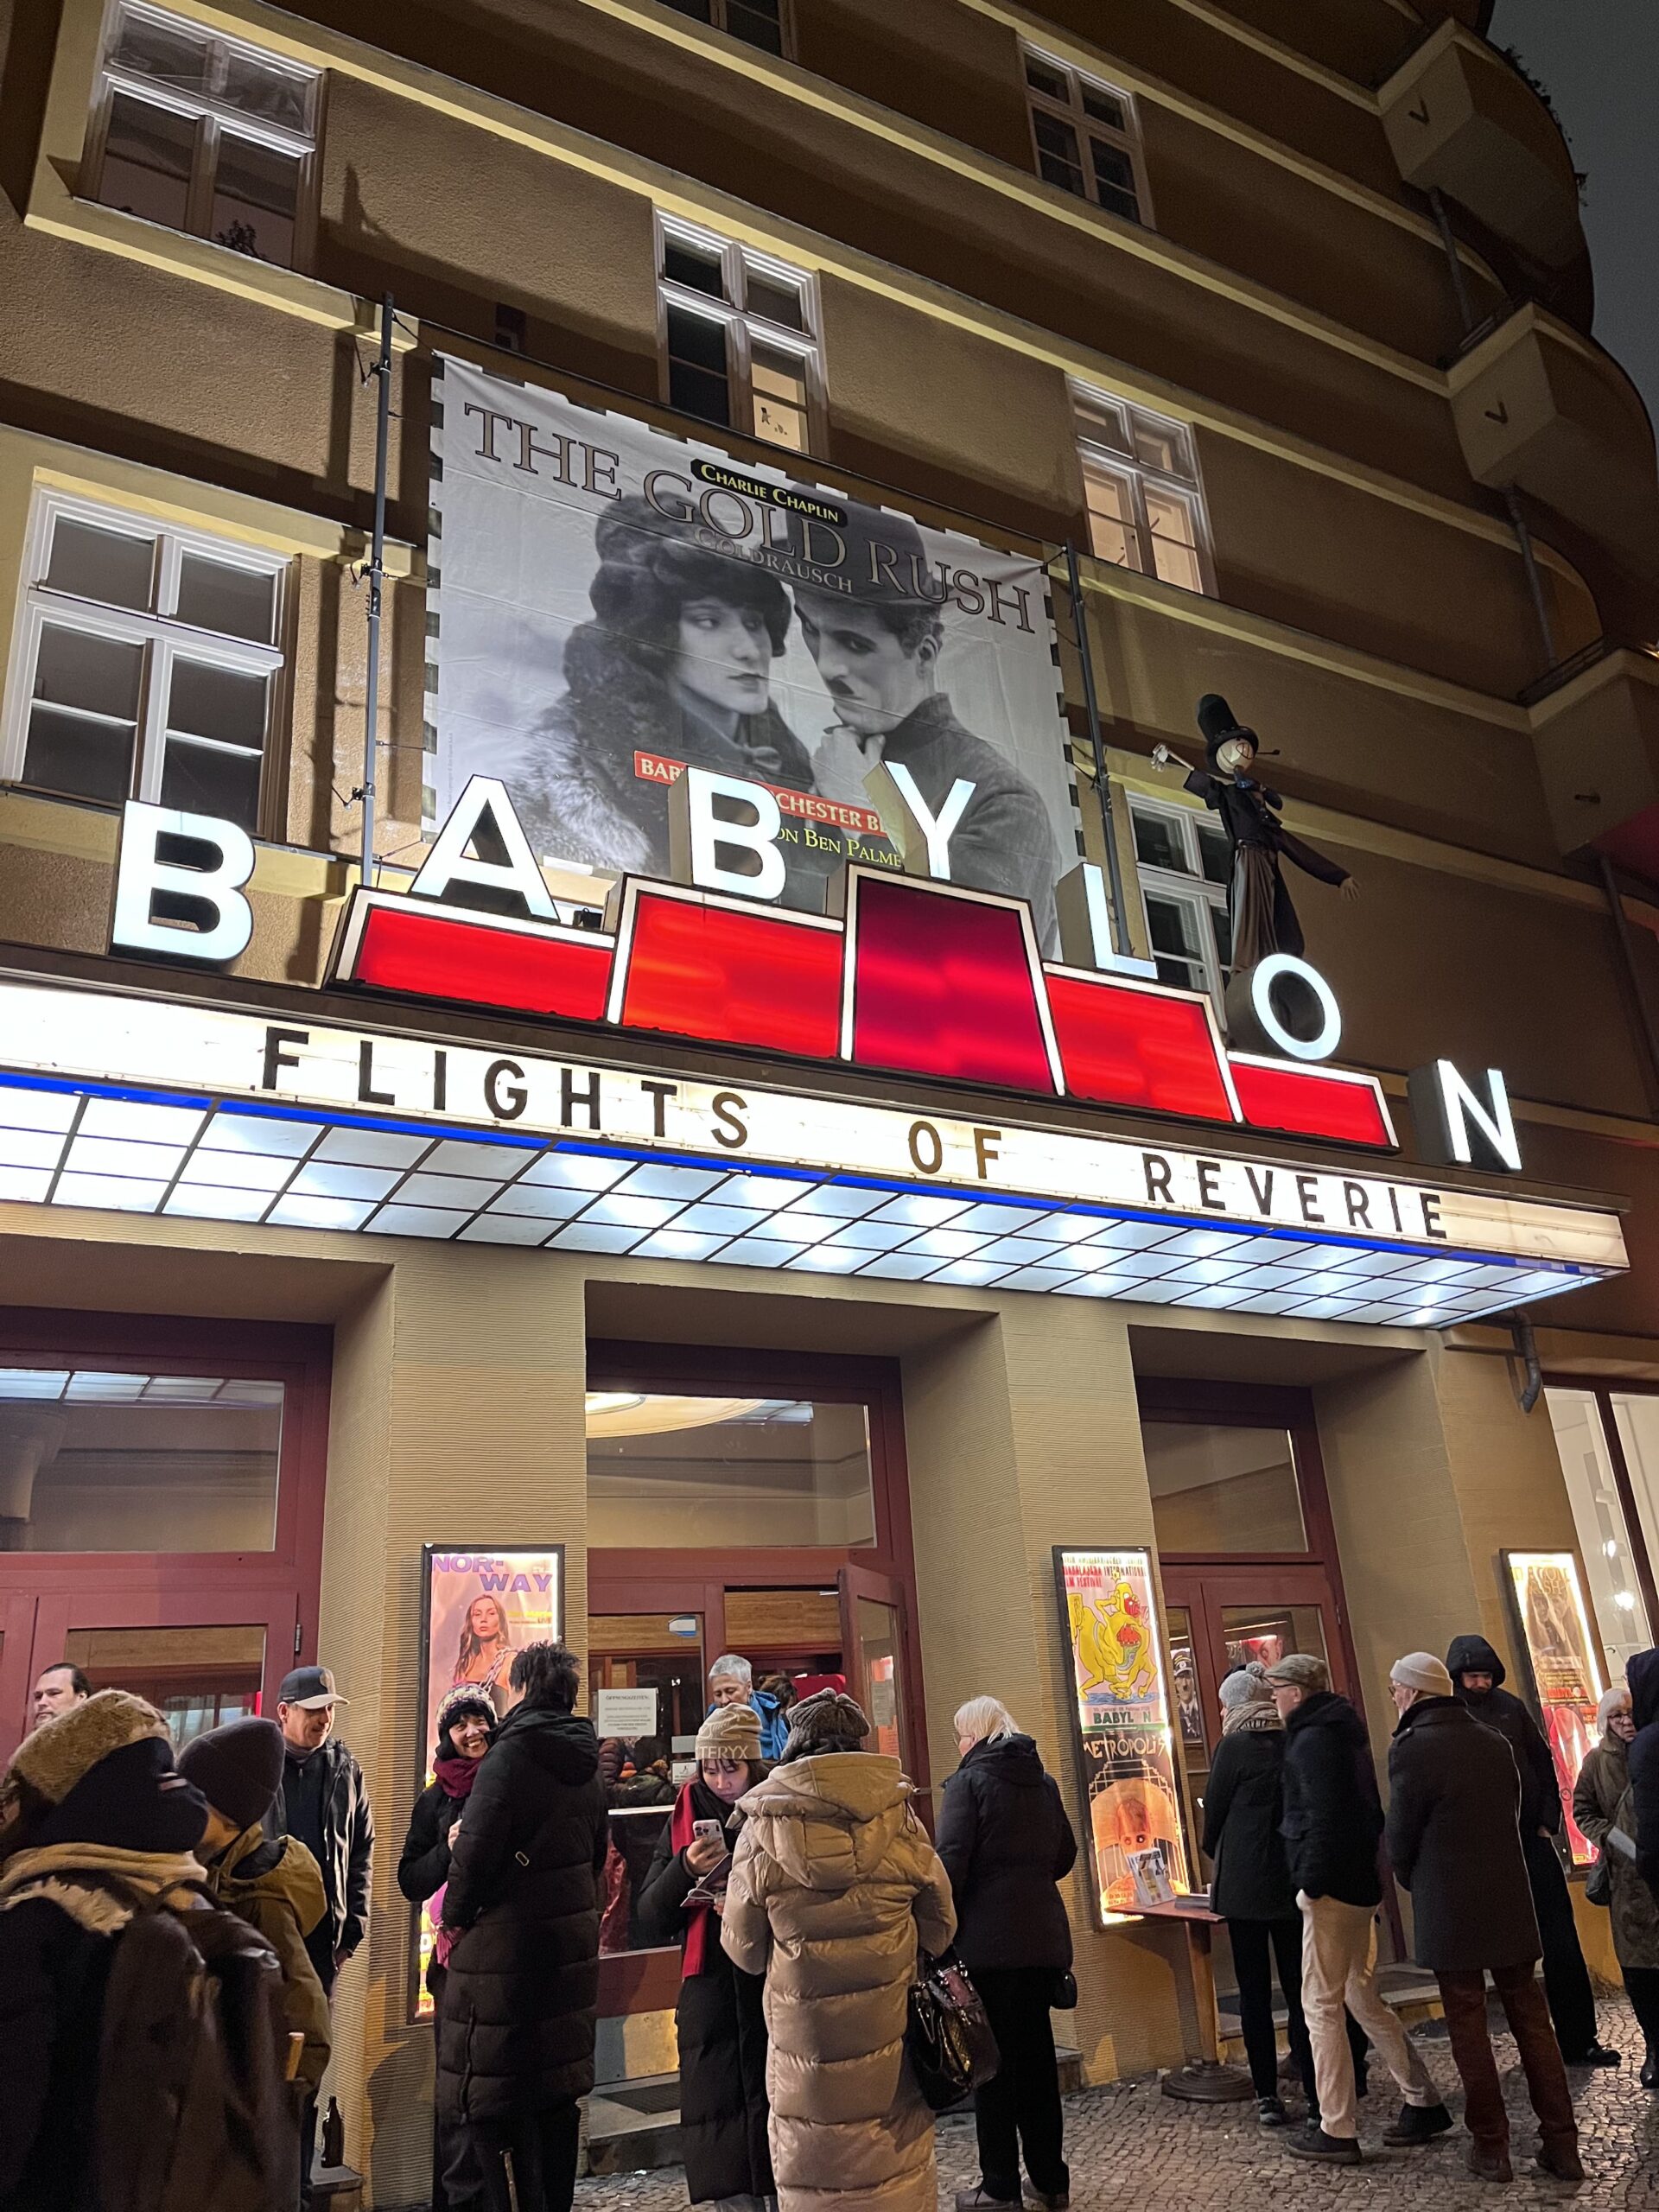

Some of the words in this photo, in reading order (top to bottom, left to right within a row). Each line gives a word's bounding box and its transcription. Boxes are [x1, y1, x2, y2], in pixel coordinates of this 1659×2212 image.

[464, 402, 621, 501] THE
[643, 469, 847, 569] GOLD
[866, 538, 1036, 634] RUSH
[700, 464, 767, 499] CHARLIE
[772, 488, 839, 523] CHAPLIN
[804, 828, 841, 854] BEN
[112, 760, 1524, 1173] BABYLON
[262, 1026, 749, 1149] FLIGHTS
[907, 1121, 1002, 1179] OF
[1141, 1152, 1448, 1239] REVERIE
[432, 1555, 504, 1573] NOR-
[480, 1573, 553, 1592] WAY
